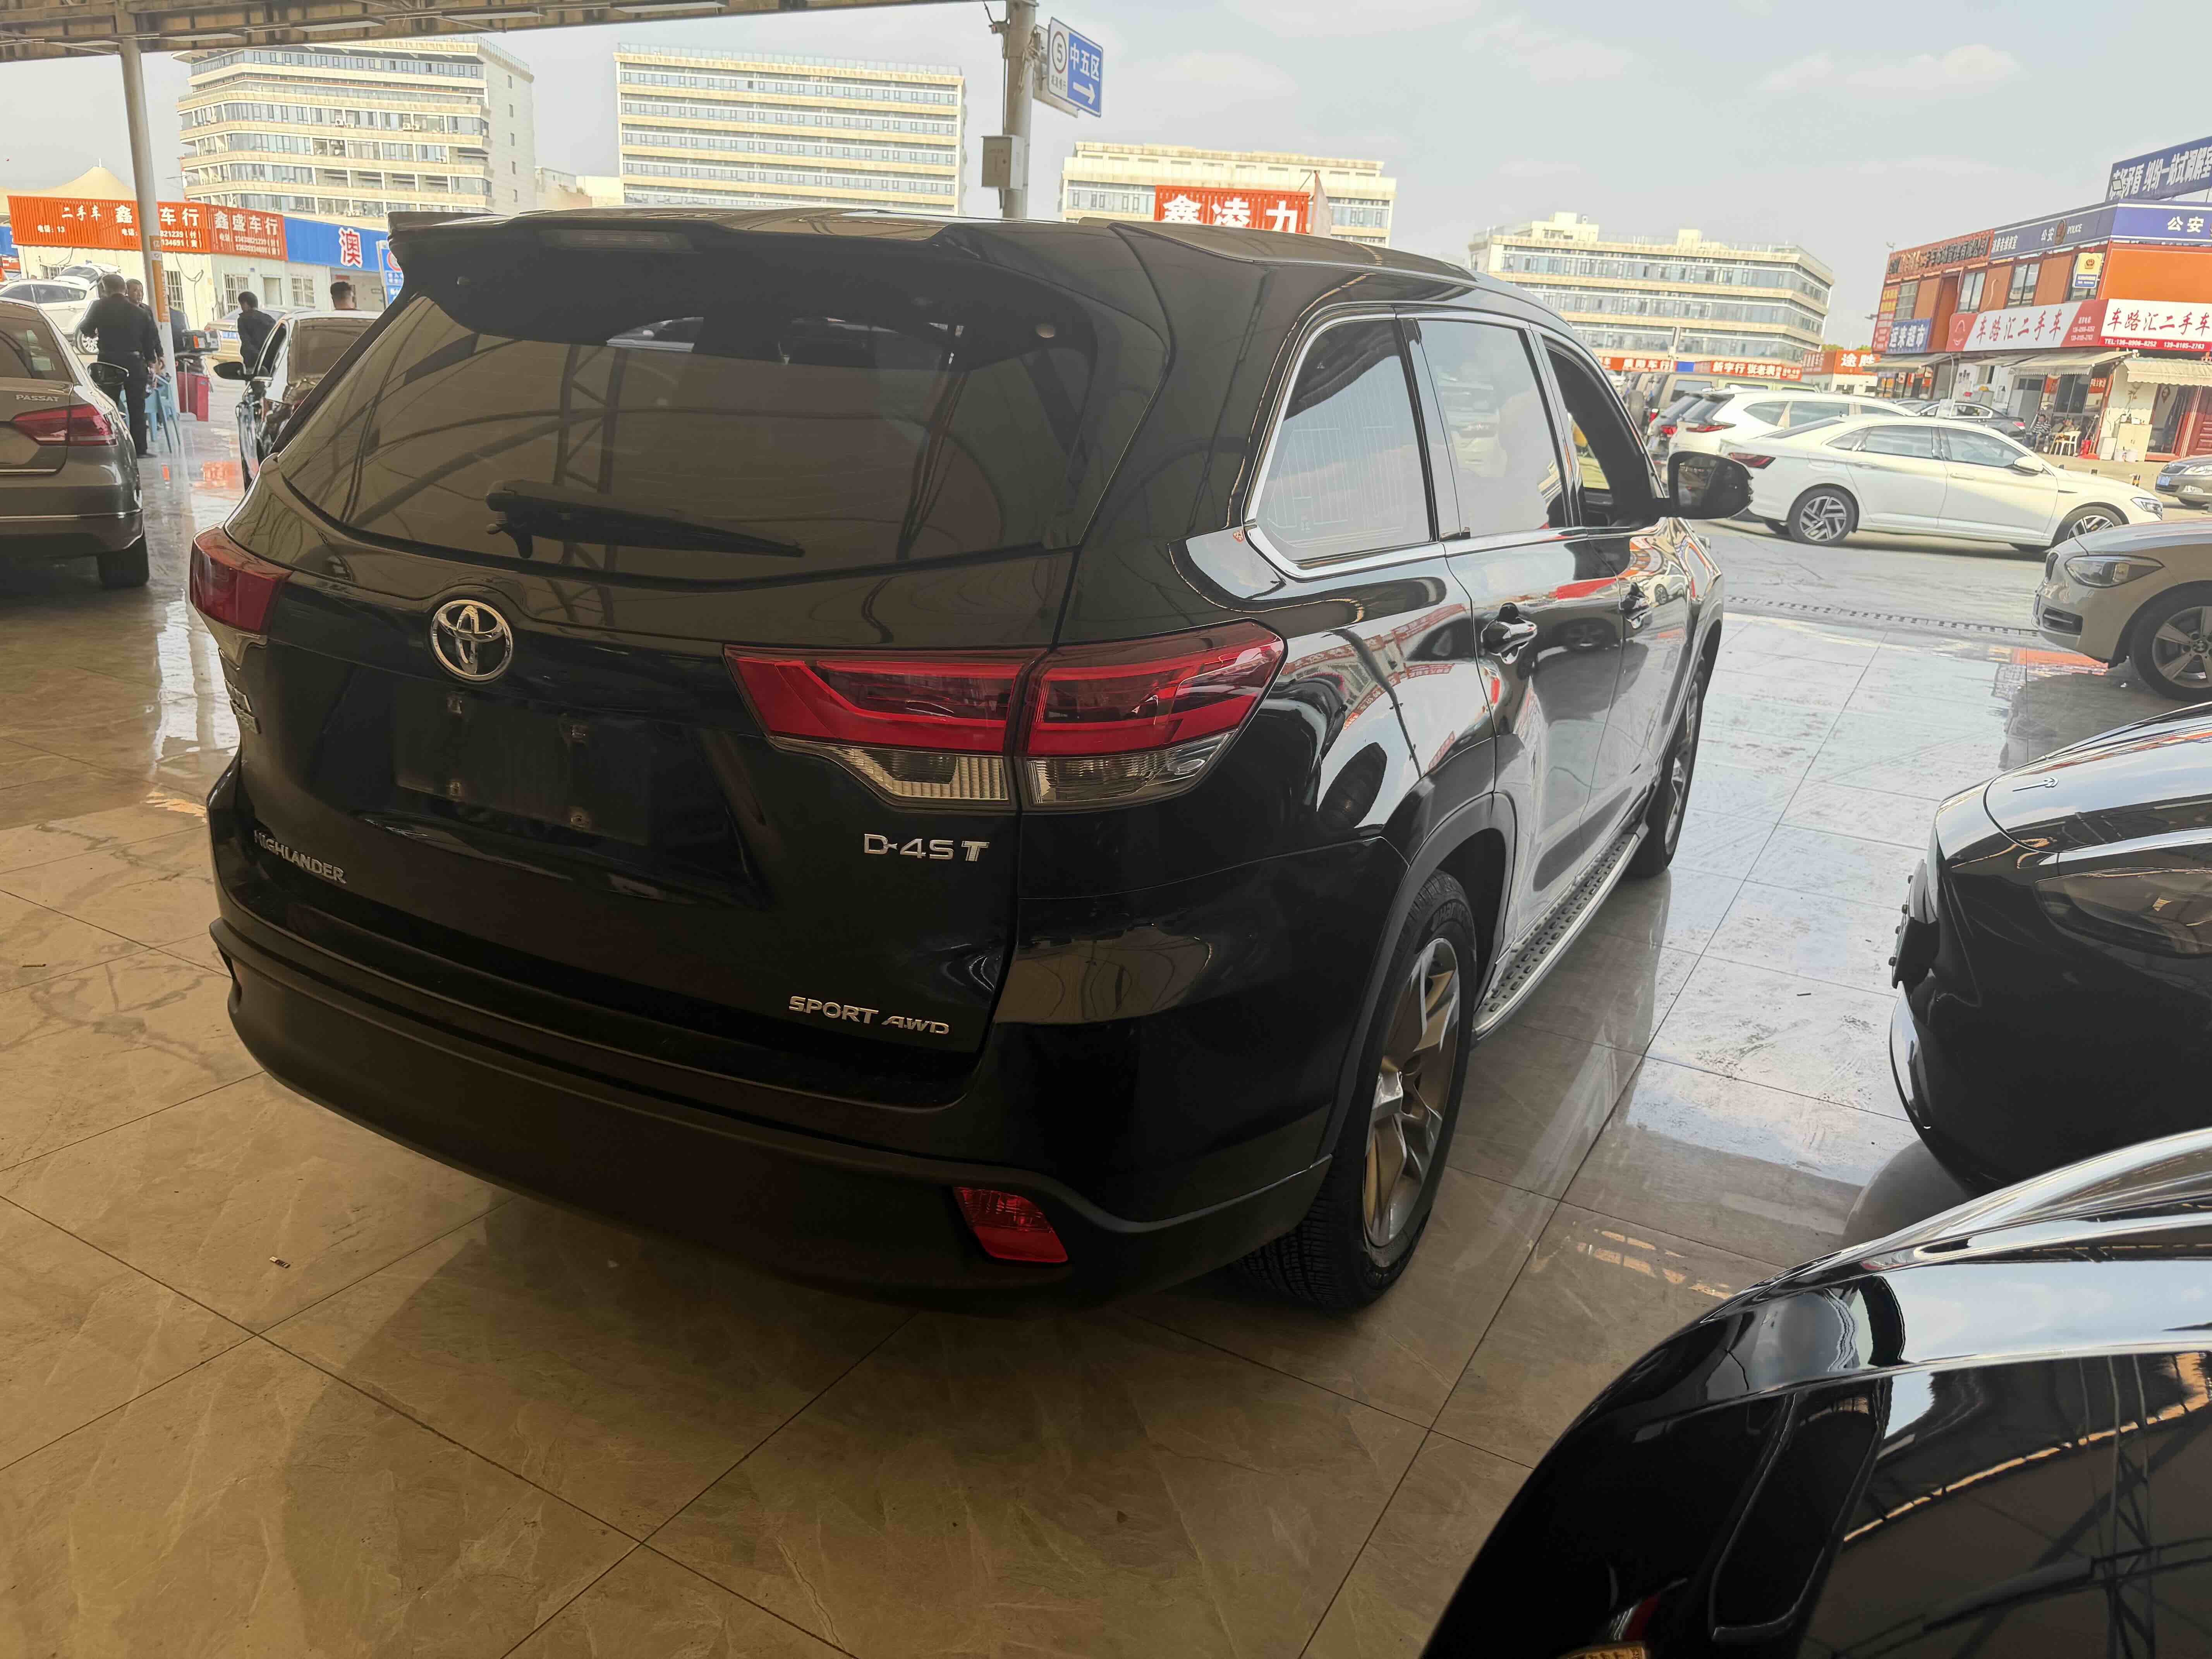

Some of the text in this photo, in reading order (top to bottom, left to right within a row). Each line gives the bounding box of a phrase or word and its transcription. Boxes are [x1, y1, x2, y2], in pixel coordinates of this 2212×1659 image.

[1057, 43, 1063, 63] 5
[1070, 43, 1099, 82] 中五区
[62, 204, 101, 222] 二手车
[215, 210, 278, 236] 鑫盛车行
[2167, 216, 2204, 233] 公安
[338, 227, 363, 268] 澳
[2040, 227, 2054, 242] 公安
[1889, 324, 1925, 348] 运来超市
[1977, 309, 2062, 345] 车路汇二手车
[2107, 308, 2210, 337] 车路汇二手车
[254, 830, 347, 884] HIGHLANDER
[789, 996, 950, 1035] SPORT AWD
